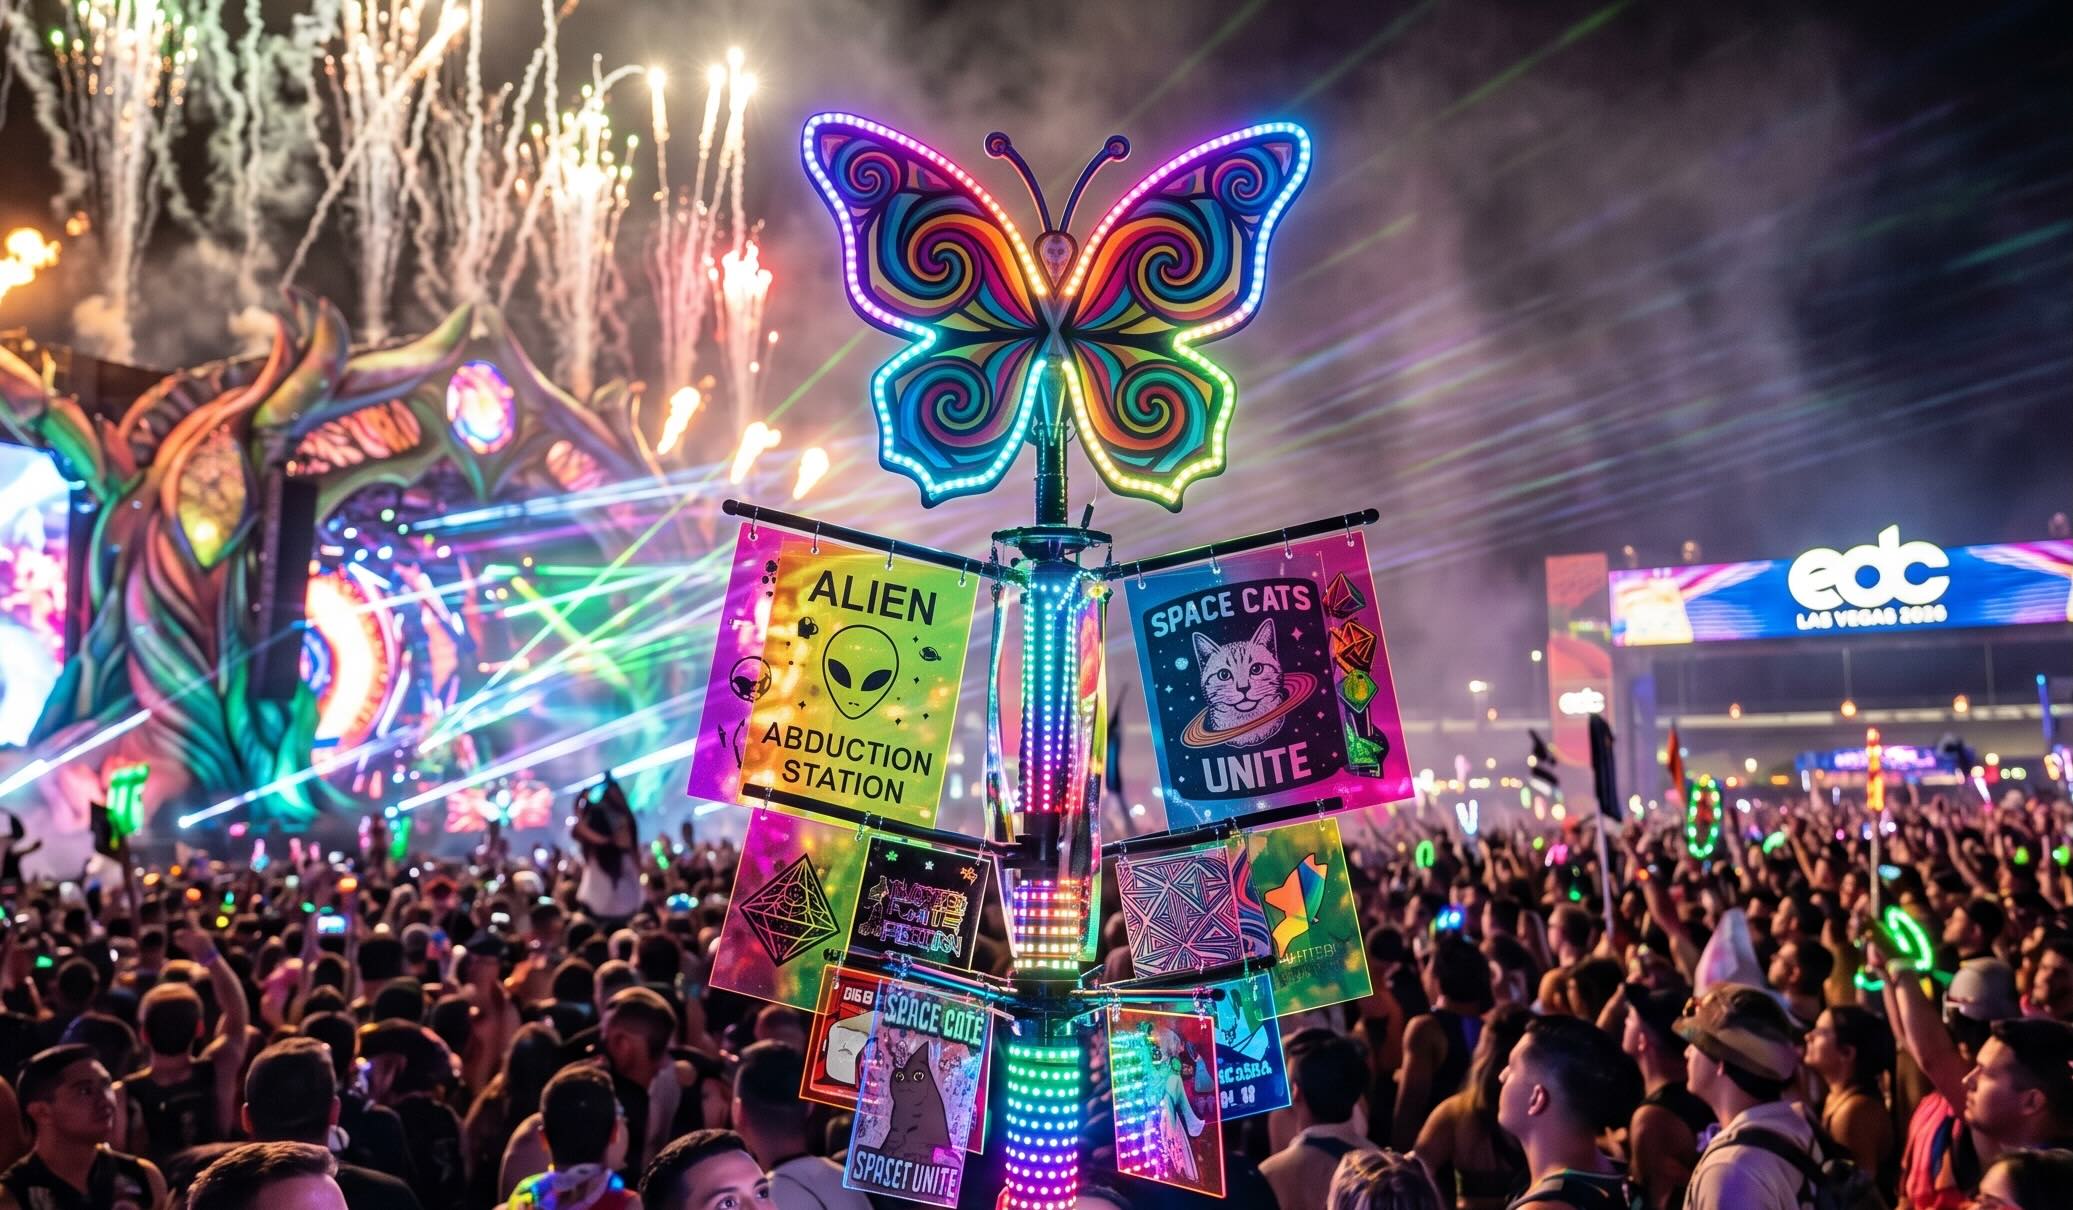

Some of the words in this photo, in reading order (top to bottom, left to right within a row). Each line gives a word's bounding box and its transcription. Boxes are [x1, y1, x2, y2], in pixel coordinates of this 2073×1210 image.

[1788, 524, 1950, 611] edc
[808, 570, 937, 625] ALIEN
[1151, 591, 1235, 638] SPACE
[1242, 585, 1312, 613] CATS
[1796, 611, 1833, 630] LAS
[1834, 607, 1897, 628] VEGAS
[761, 722, 933, 776] ABDUCTION
[1202, 742, 1312, 793] UNITE
[782, 759, 905, 804] STATION
[911, 1163, 959, 1198] UNITE
